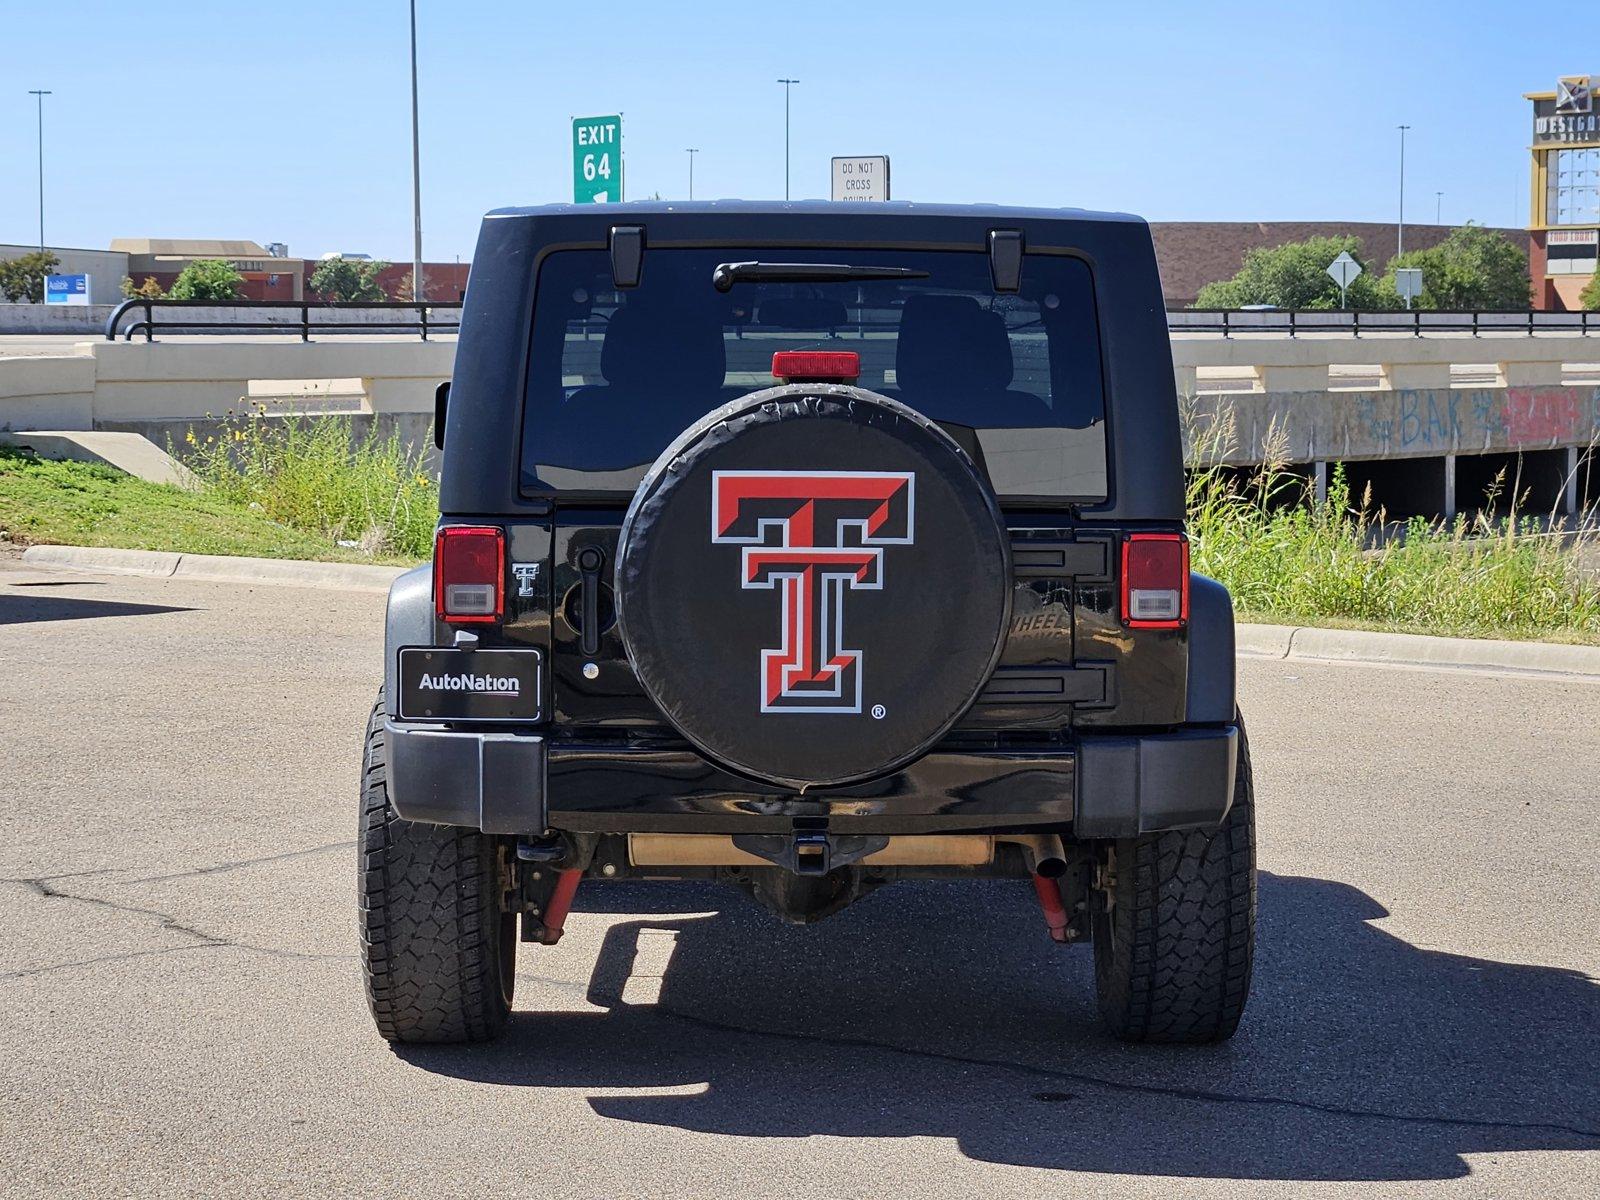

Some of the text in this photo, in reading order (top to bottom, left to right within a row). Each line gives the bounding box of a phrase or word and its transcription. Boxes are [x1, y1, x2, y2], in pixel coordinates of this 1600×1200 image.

[578, 124, 616, 146] EXIT
[583, 153, 611, 182] 64
[843, 162, 874, 174] DO NOT
[846, 179, 871, 190] CROSS
[419, 672, 520, 691] AutoNation
